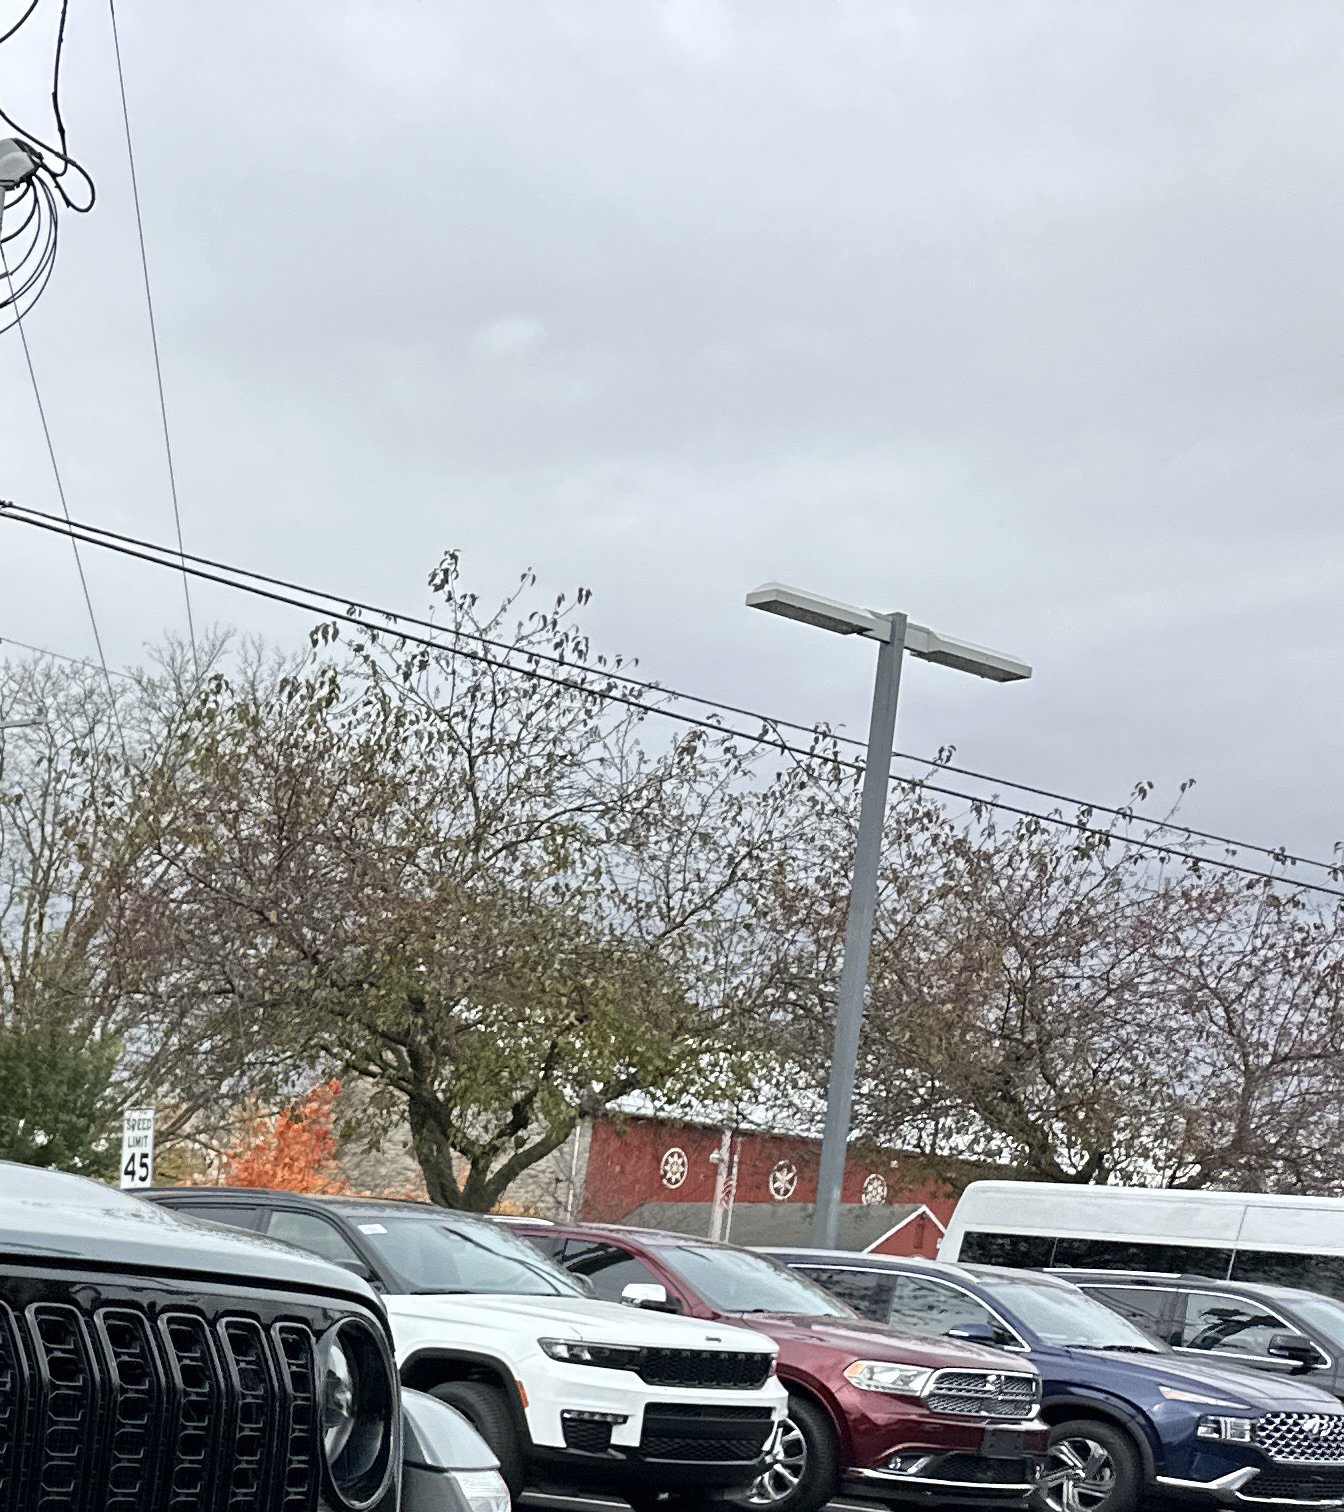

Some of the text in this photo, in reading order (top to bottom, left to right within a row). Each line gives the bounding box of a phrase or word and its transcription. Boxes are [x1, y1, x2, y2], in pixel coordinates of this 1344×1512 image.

[126, 1119, 152, 1131] SPEED
[127, 1135, 149, 1148] LIMIT
[123, 1152, 149, 1182] 45
